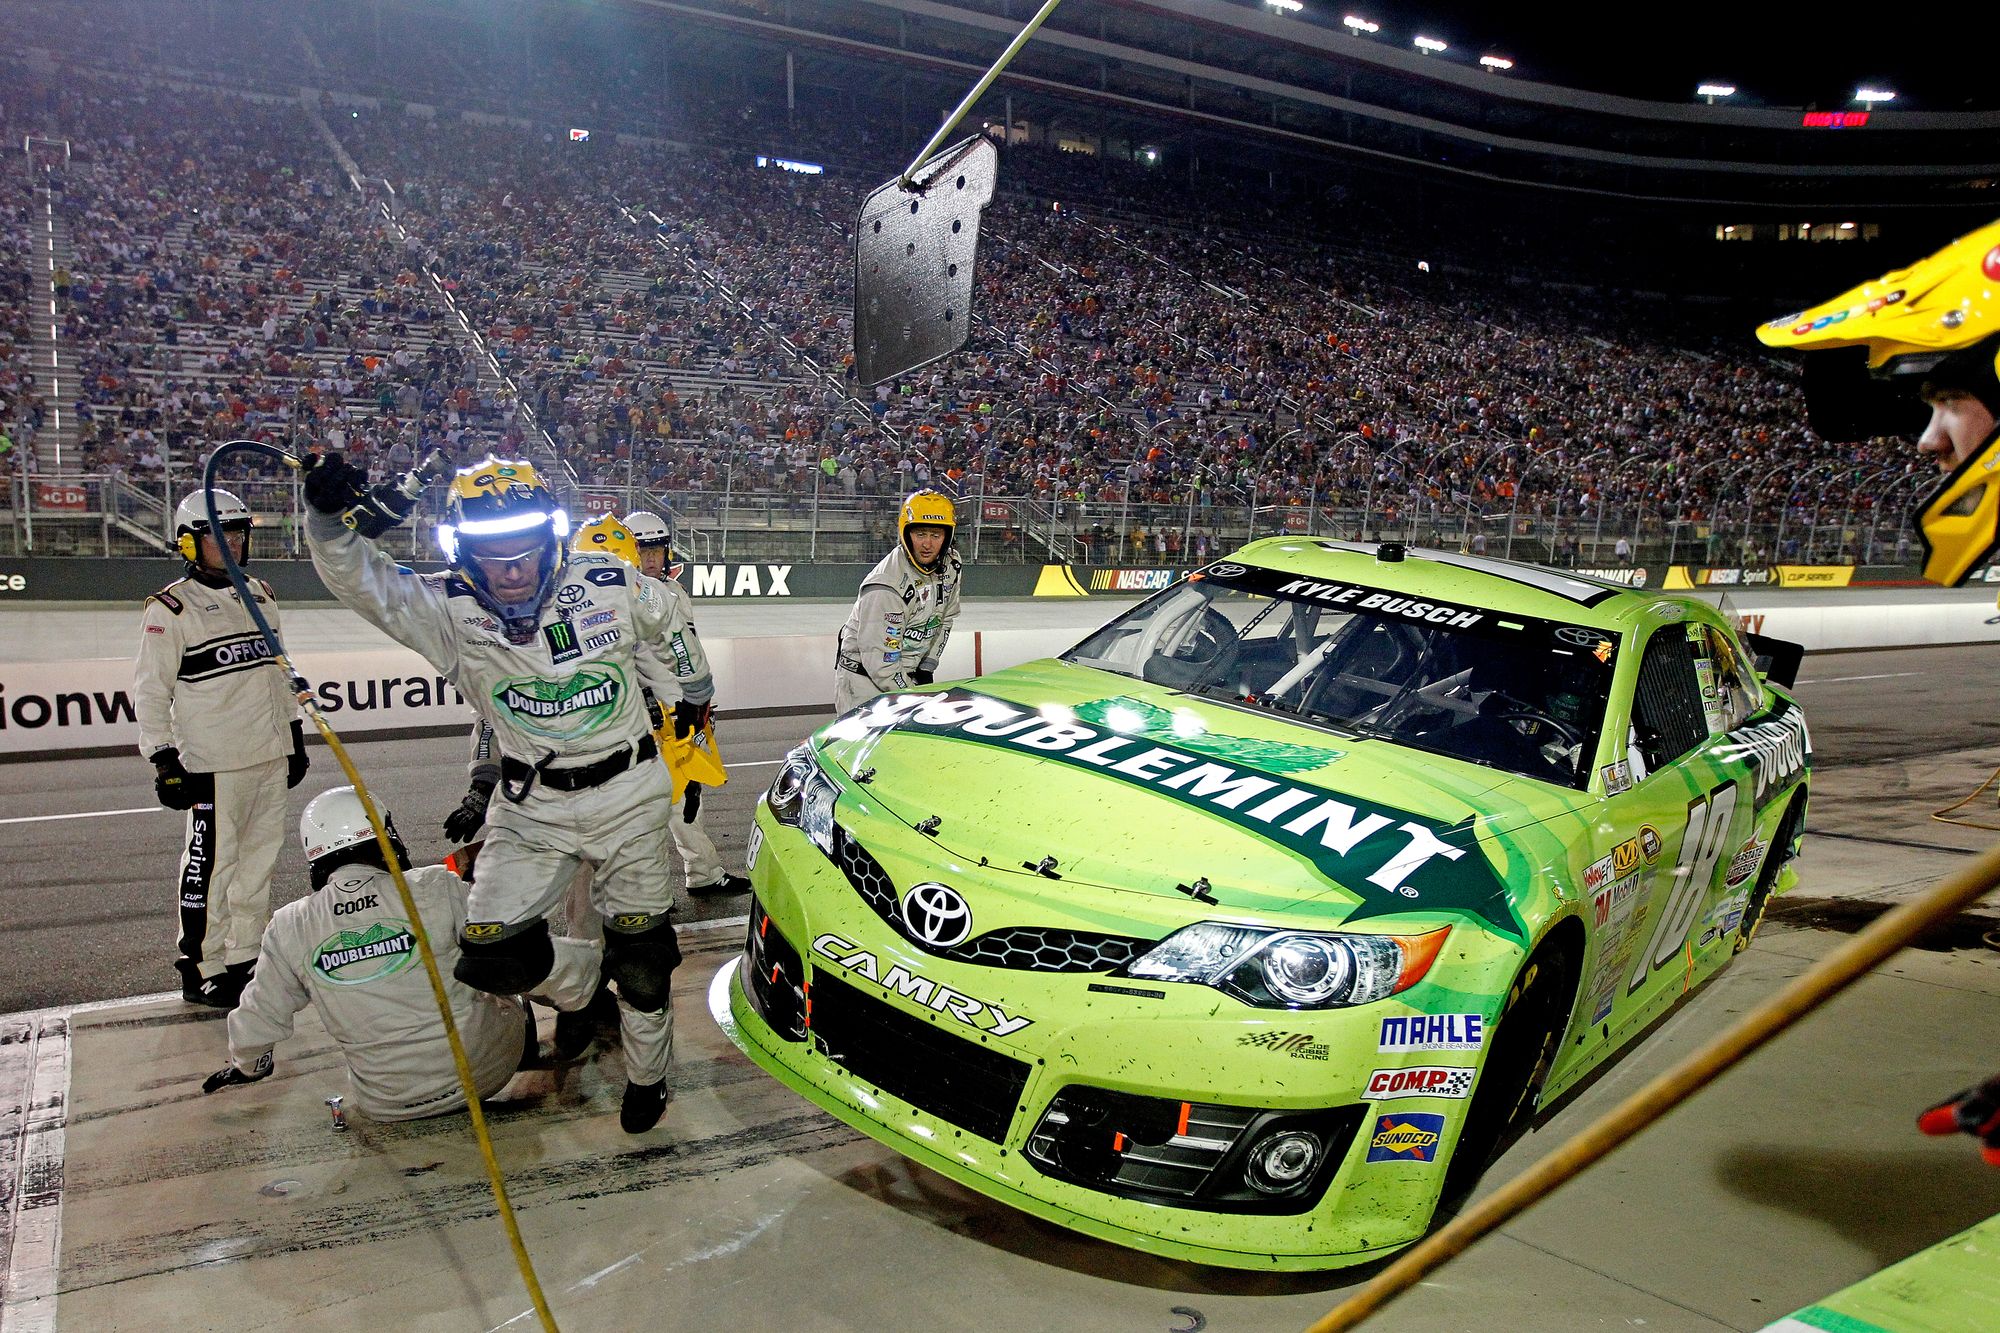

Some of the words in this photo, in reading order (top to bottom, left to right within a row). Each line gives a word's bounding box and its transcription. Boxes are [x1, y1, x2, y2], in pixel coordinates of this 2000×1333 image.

[691, 564, 793, 597] MAX
[1116, 569, 1172, 589] NASCAR
[1742, 568, 1768, 586] Sprint
[1276, 580, 1358, 605] KYLE
[1359, 588, 1485, 629] BUSCH
[215, 639, 272, 665] OFFICI
[508, 680, 614, 717] DOUBLEMINT
[186, 819, 207, 885] Sprint
[184, 893, 203, 901] CUP
[1626, 780, 1738, 998] 18
[333, 894, 380, 916] COOK
[320, 934, 411, 972] DOUBLEMINT
[811, 933, 1036, 1037] CAMRY
[1379, 1014, 1482, 1046] MAHLE
[1290, 1052, 1329, 1061] RACING
[1448, 1042, 1482, 1050] BEARINGS
[1369, 1070, 1448, 1093] COMP
[1418, 1085, 1462, 1095] CAMS
[1377, 1131, 1435, 1147] SUNOCO
